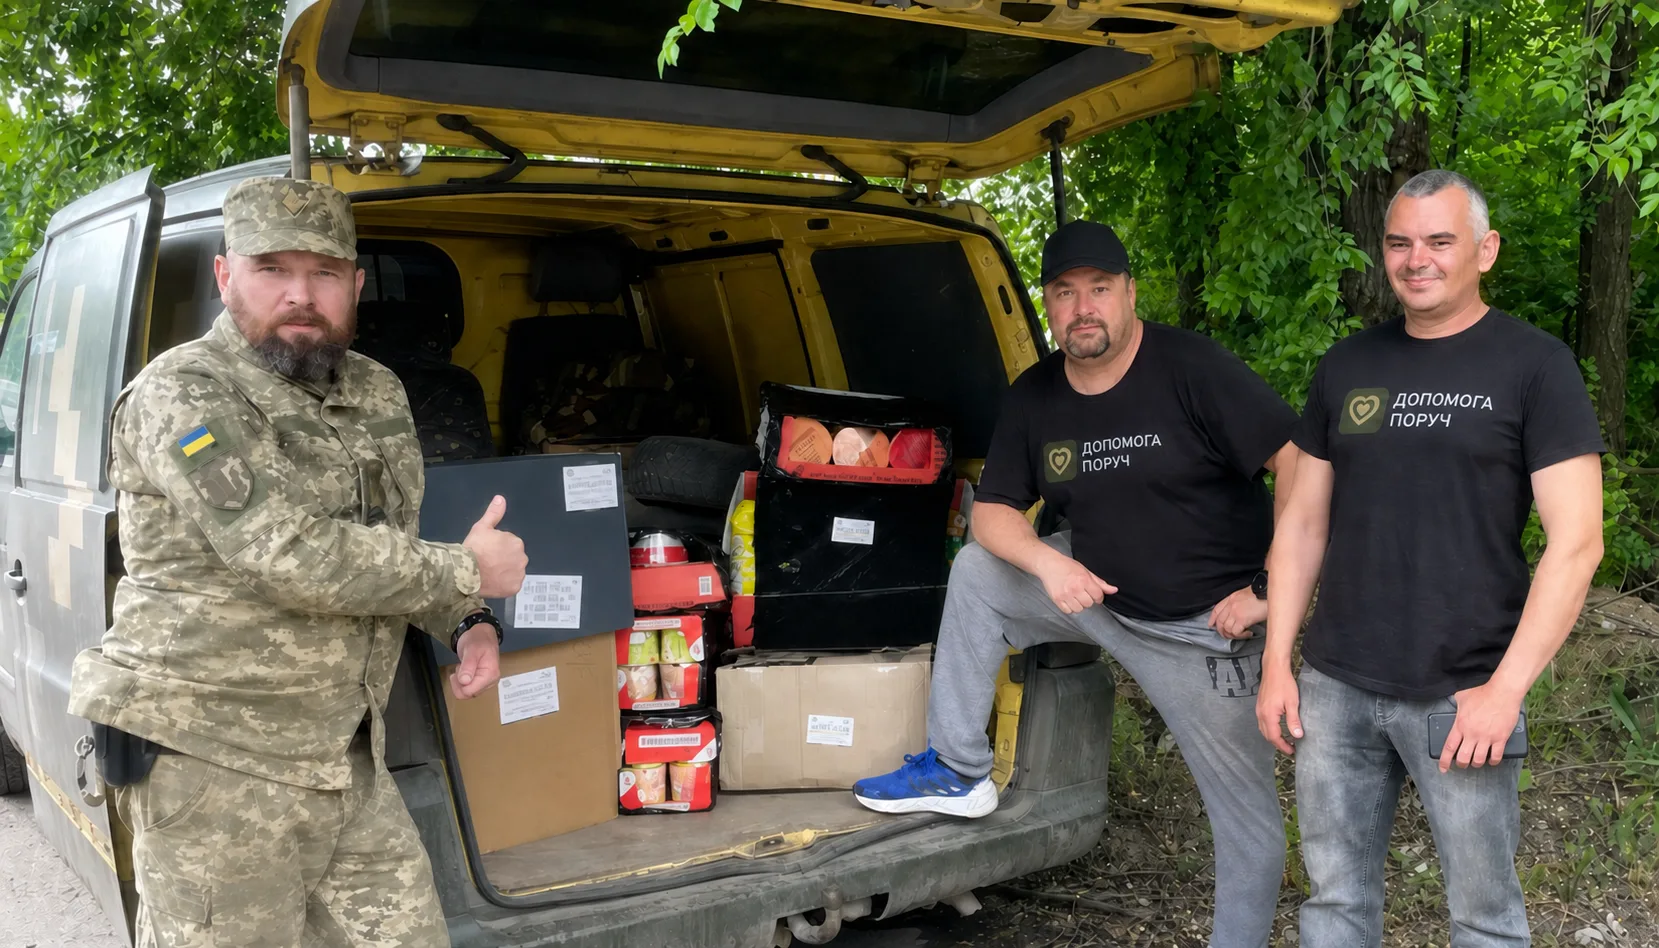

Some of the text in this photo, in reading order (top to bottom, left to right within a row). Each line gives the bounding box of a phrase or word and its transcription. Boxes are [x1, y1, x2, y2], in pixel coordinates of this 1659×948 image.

[1392, 393, 1493, 411] ДОПОМОГА
[1390, 413, 1452, 428] ПОРУЧ
[1082, 434, 1162, 457] ДОПОМОГА
[1082, 454, 1130, 472] ПОРУЧ
